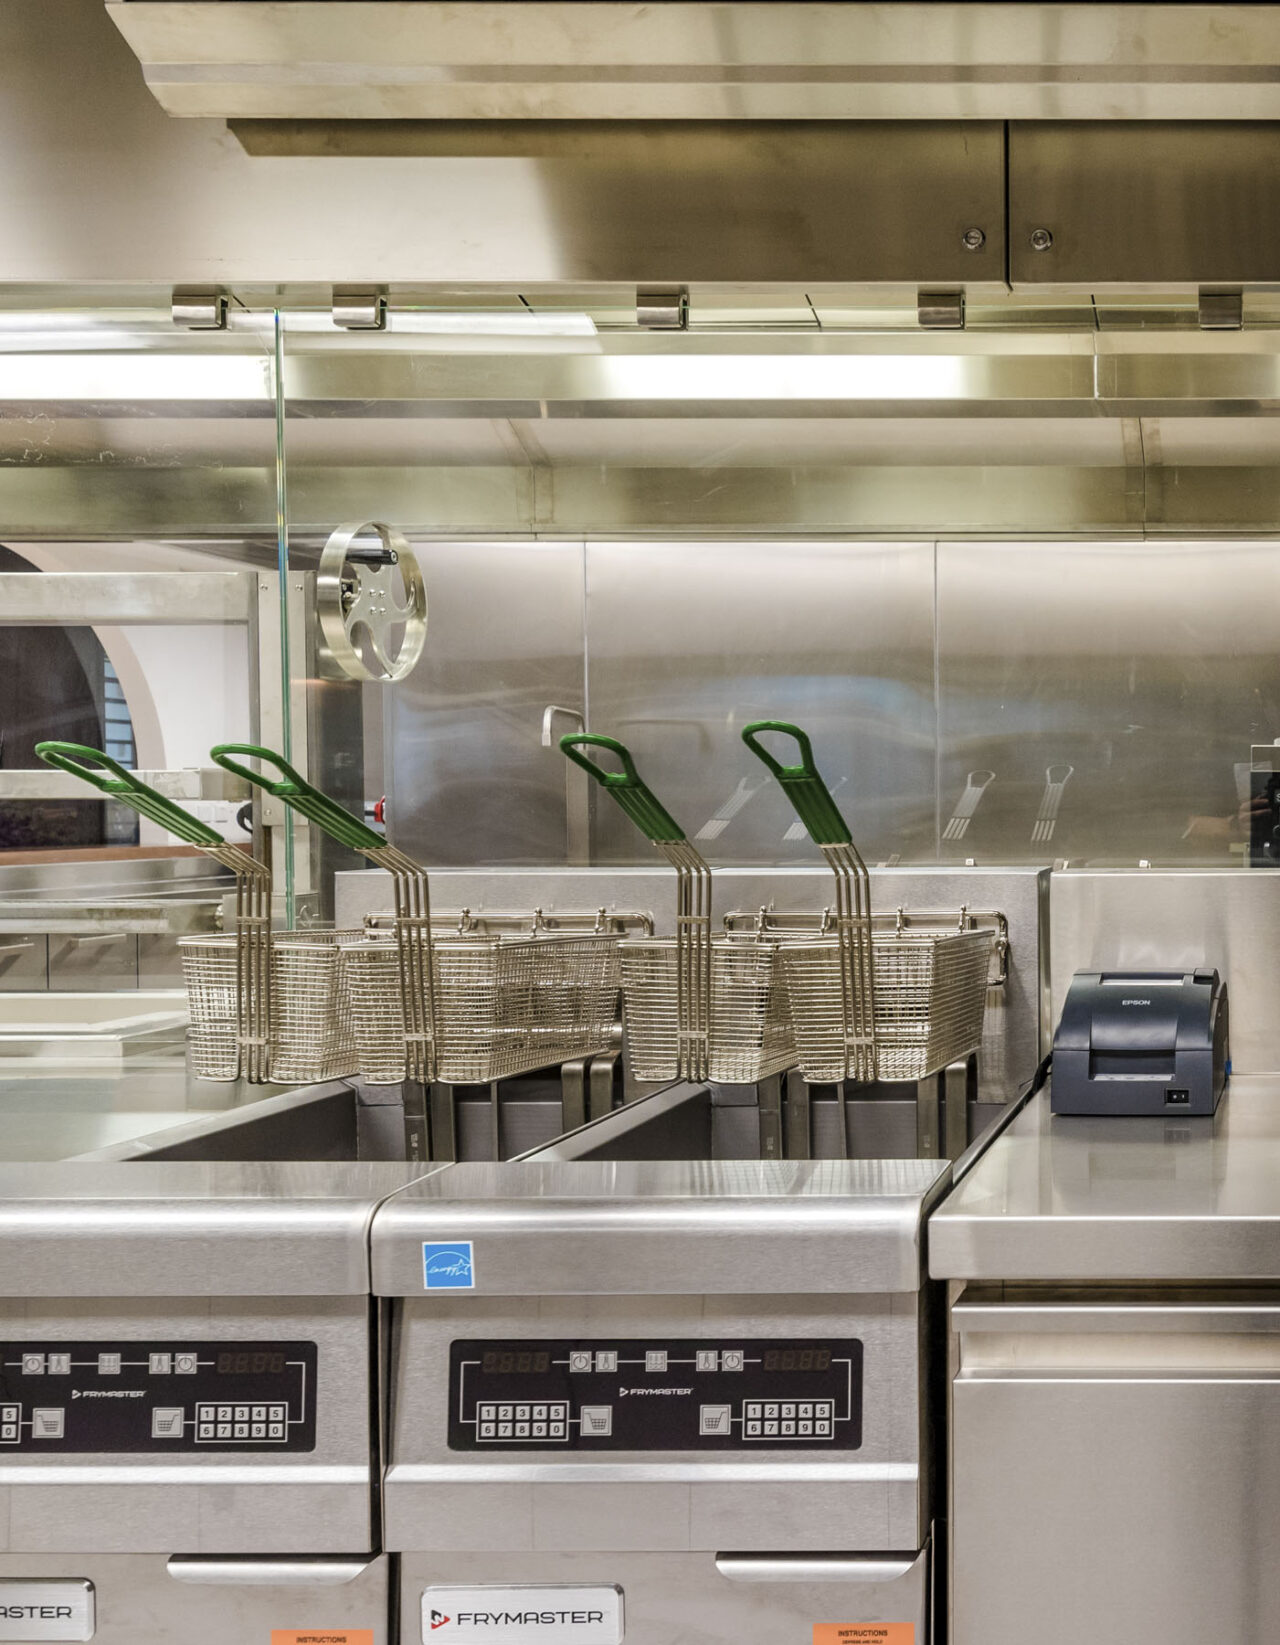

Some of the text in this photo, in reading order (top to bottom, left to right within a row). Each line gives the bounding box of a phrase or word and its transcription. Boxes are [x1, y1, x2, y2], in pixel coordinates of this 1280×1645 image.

[82, 1390, 146, 1398] FRYMASTER
[630, 1388, 692, 1396] FRYMASTER
[457, 1611, 604, 1626] FRYMASTER
[296, 1636, 347, 1644] INSTRUCTIONS
